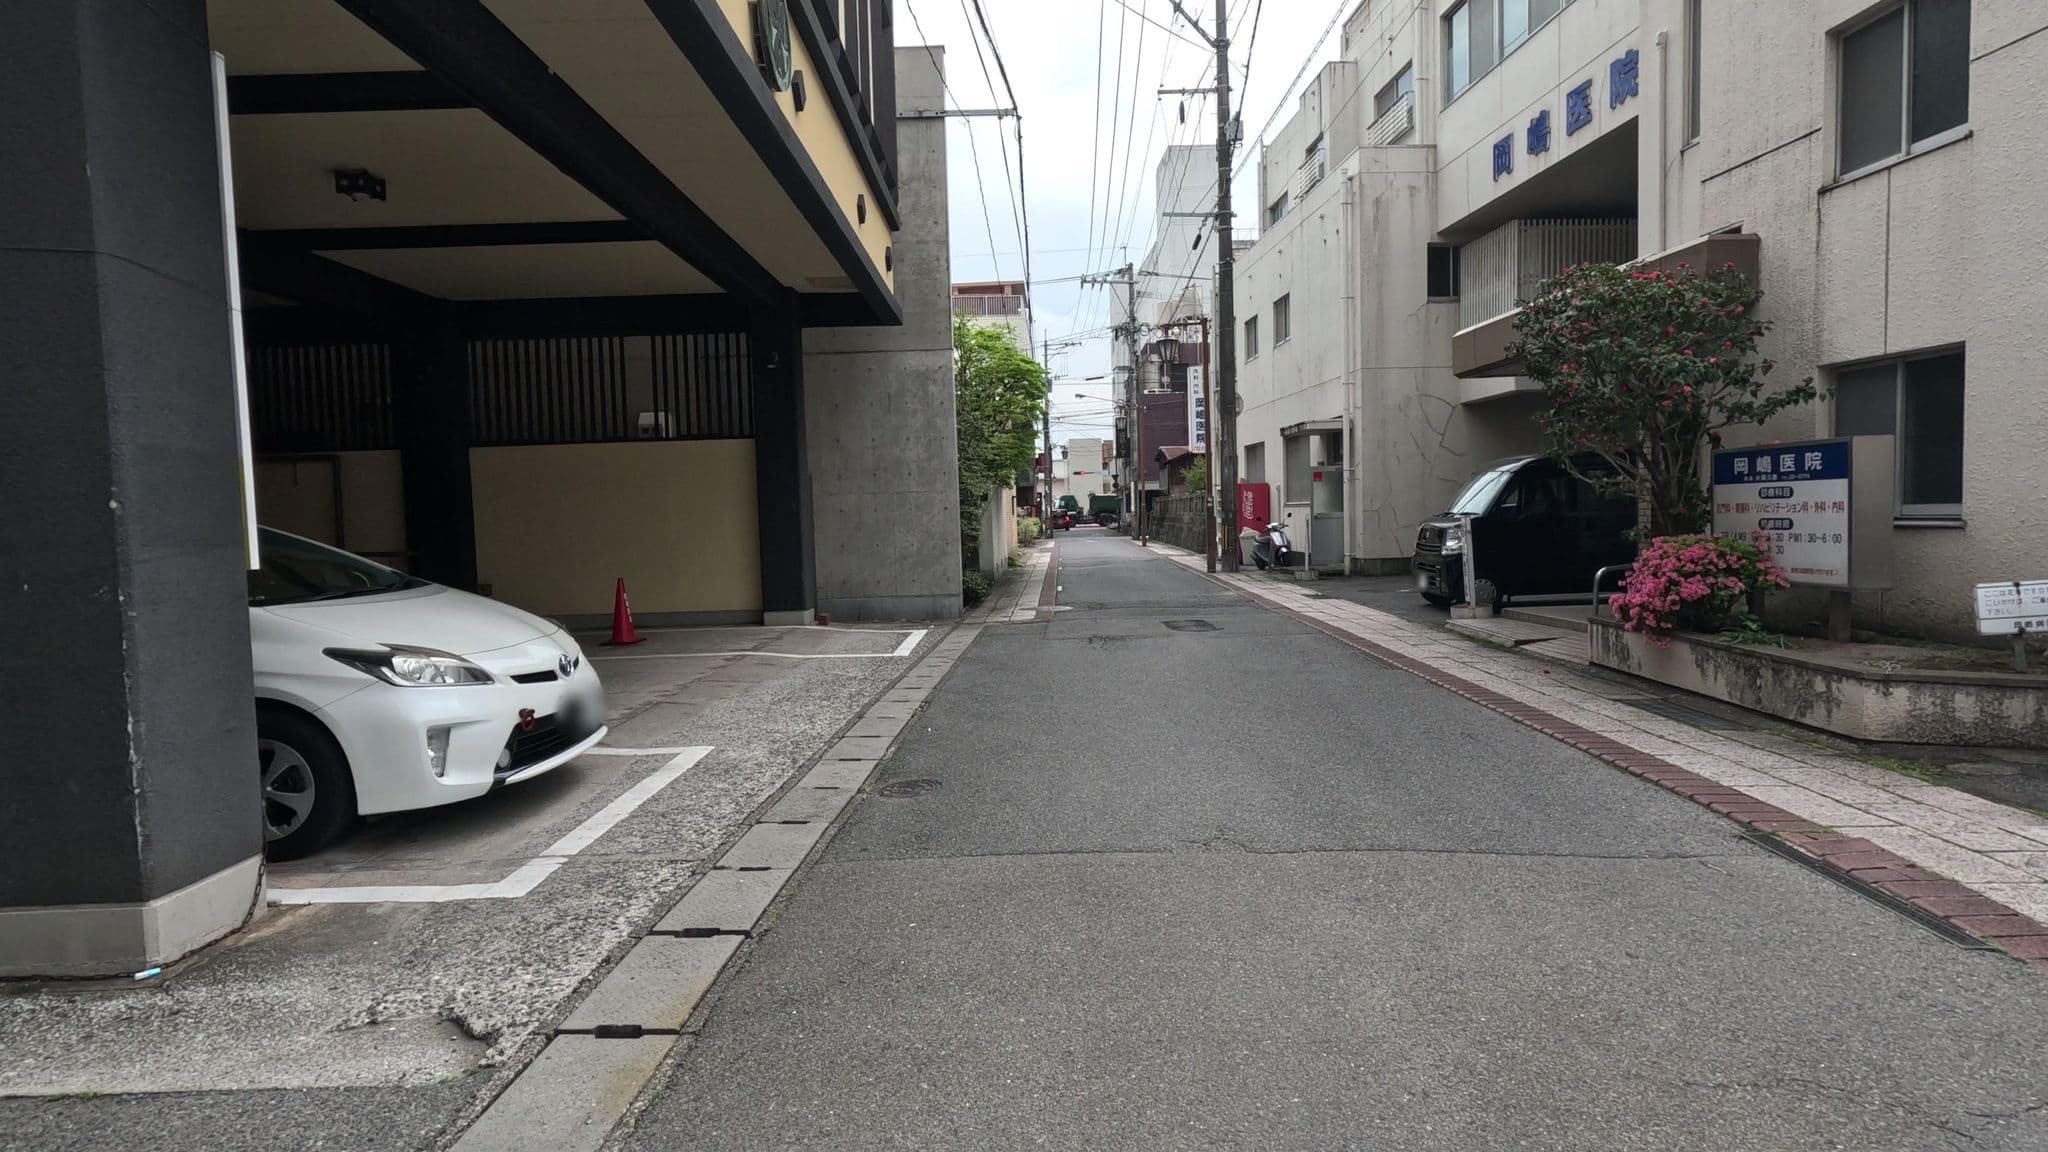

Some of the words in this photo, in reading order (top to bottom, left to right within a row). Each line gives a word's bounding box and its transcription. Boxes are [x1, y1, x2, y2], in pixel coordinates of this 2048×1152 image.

[1734, 452, 1823, 475] 岡嶋医院
[1760, 487, 1791, 498] 診療科目
